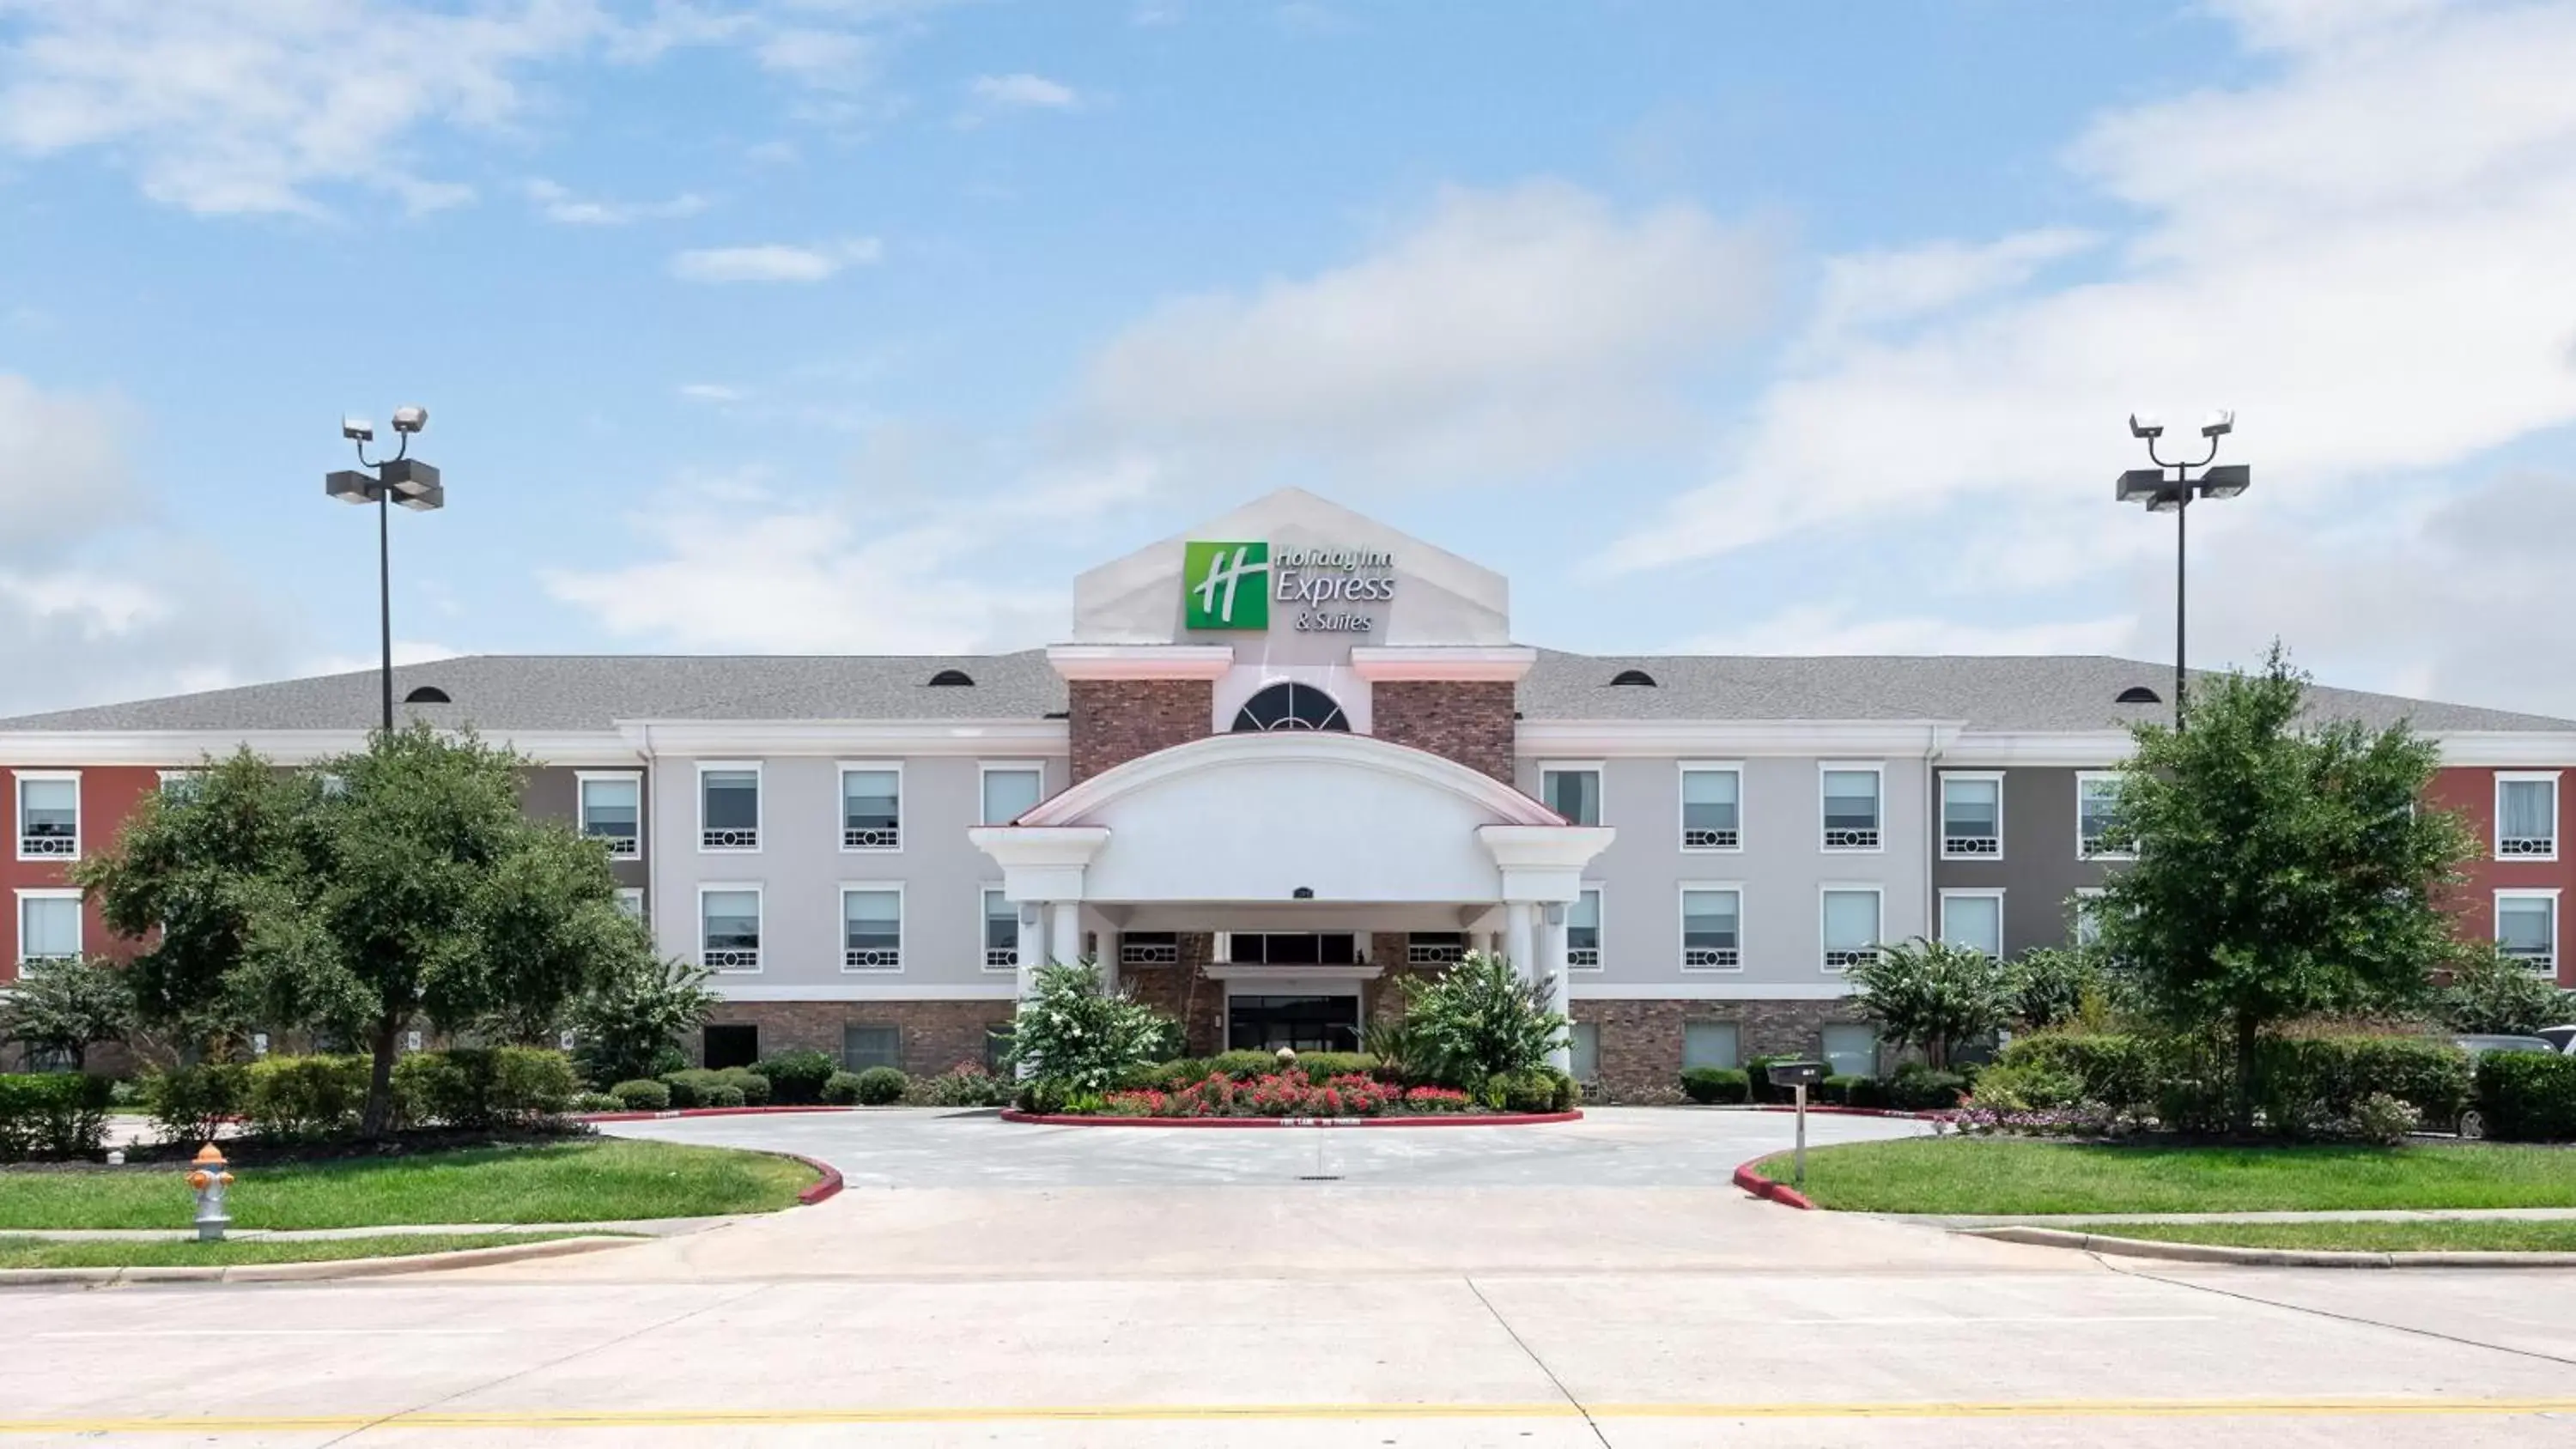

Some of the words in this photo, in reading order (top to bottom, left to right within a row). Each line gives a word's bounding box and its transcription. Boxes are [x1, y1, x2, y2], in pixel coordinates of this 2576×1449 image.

[1276, 546, 1356, 571] Holiday
[1360, 547, 1394, 567] Inn
[1276, 570, 1394, 609] Express
[1296, 611, 1309, 630] &
[1315, 611, 1371, 631] Suites
